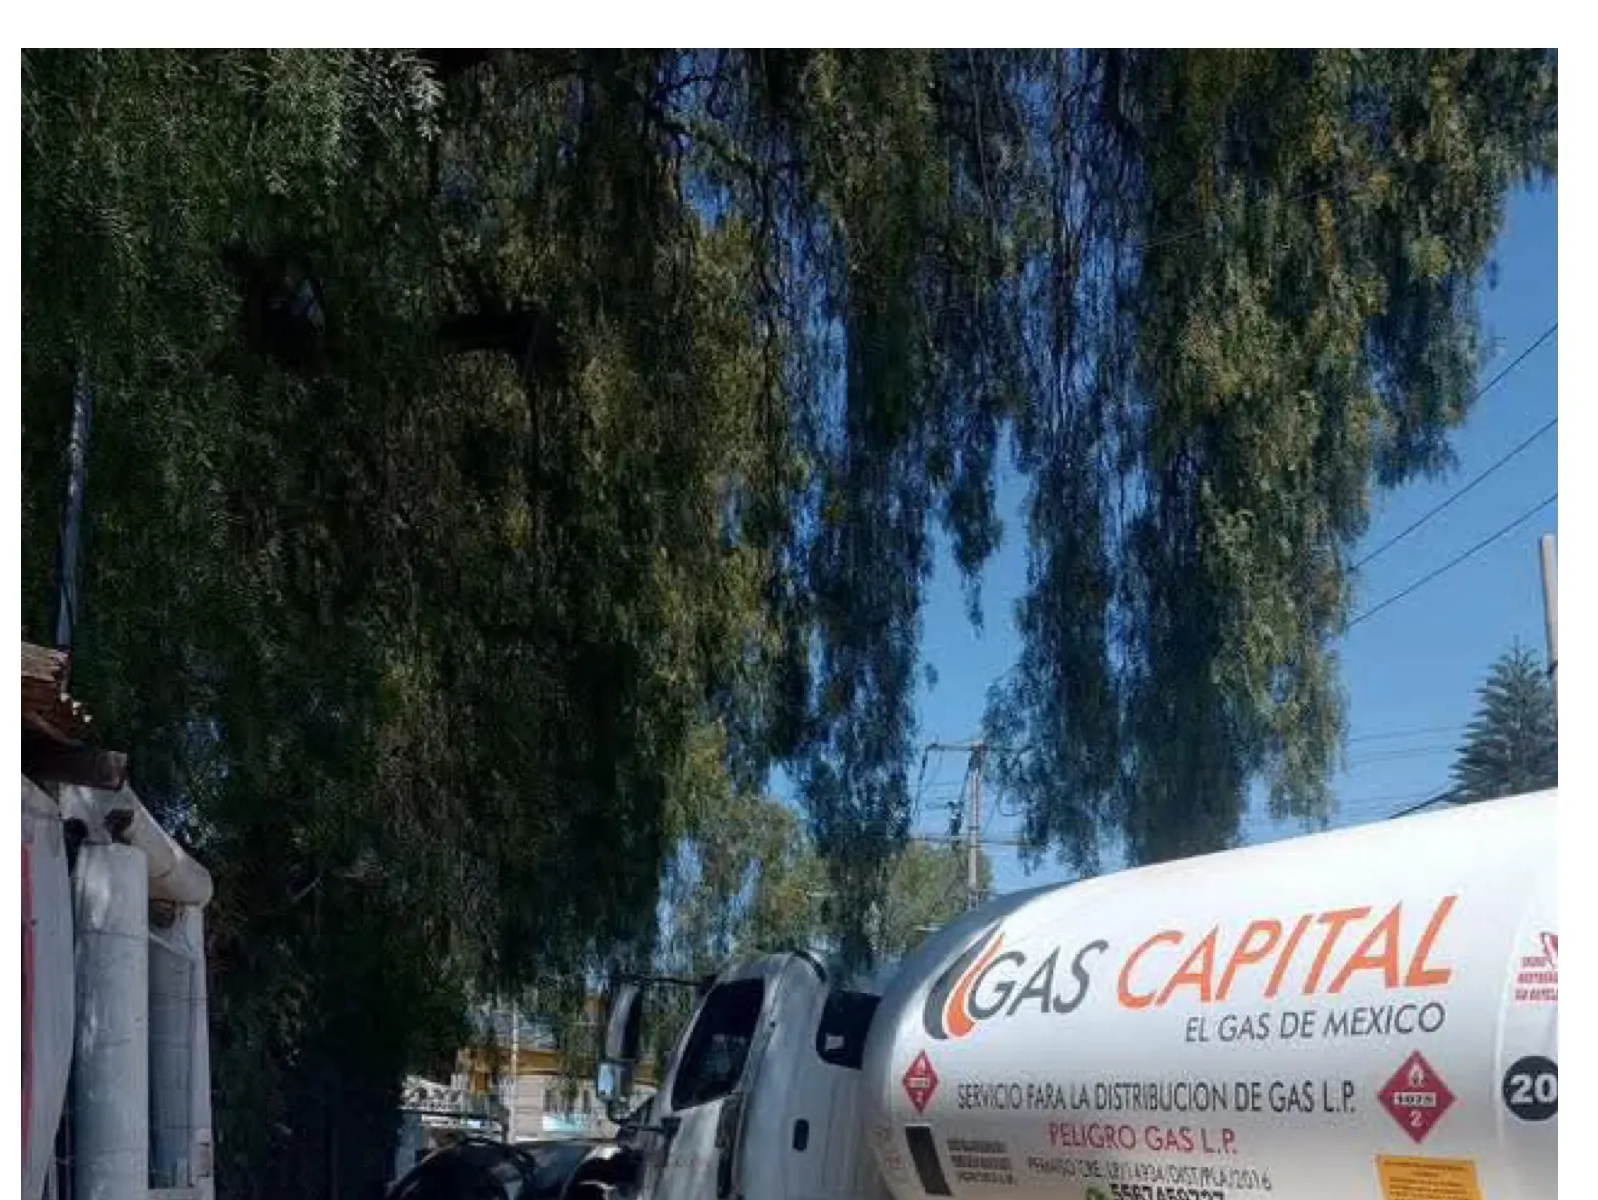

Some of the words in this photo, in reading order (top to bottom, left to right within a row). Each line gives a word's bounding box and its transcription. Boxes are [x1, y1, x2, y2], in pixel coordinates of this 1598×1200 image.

[967, 938, 1110, 1021] GAS
[1117, 895, 1459, 1009] CAPITAL
[1185, 1016, 1209, 1043] EL
[1217, 1012, 1271, 1042] GAS
[1279, 1010, 1316, 1039] DE
[1321, 1002, 1446, 1038] MEXICO
[957, 1081, 1023, 1111] SERVICIO
[1026, 1081, 1067, 1111] PARA
[1070, 1081, 1091, 1111] LA
[1094, 1081, 1229, 1112] DISTRIBUCION
[1234, 1081, 1262, 1112] DE
[1268, 1080, 1315, 1113] GAS
[1323, 1079, 1357, 1113] L.P.
[1509, 1073, 1558, 1104] 20
[1410, 1109, 1423, 1127] 2
[1048, 1120, 1137, 1151] PELIGRO
[1144, 1124, 1195, 1153] GAS
[1200, 1127, 1239, 1154] L.P.
